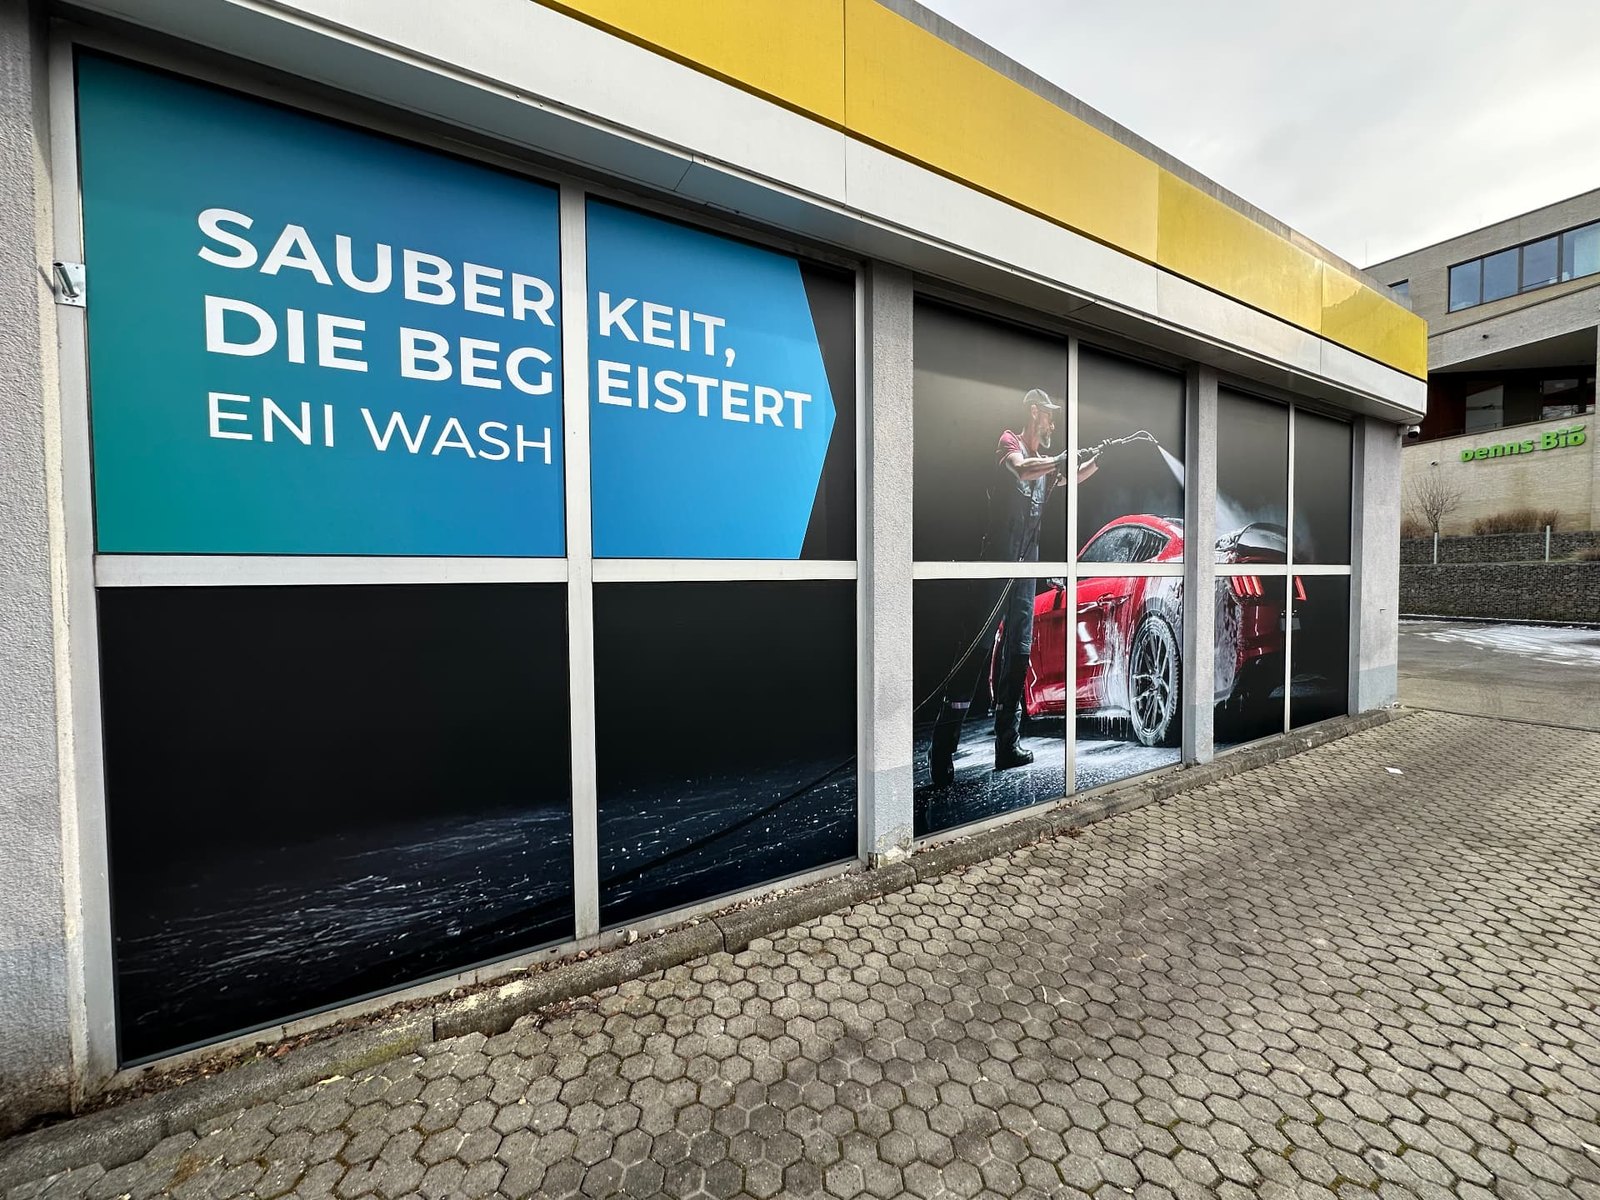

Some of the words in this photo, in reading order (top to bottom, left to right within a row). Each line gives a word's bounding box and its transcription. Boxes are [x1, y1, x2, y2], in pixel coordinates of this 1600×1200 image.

[204, 294, 368, 372] DIE
[208, 391, 335, 448] ENI
[360, 407, 553, 465] WASH
